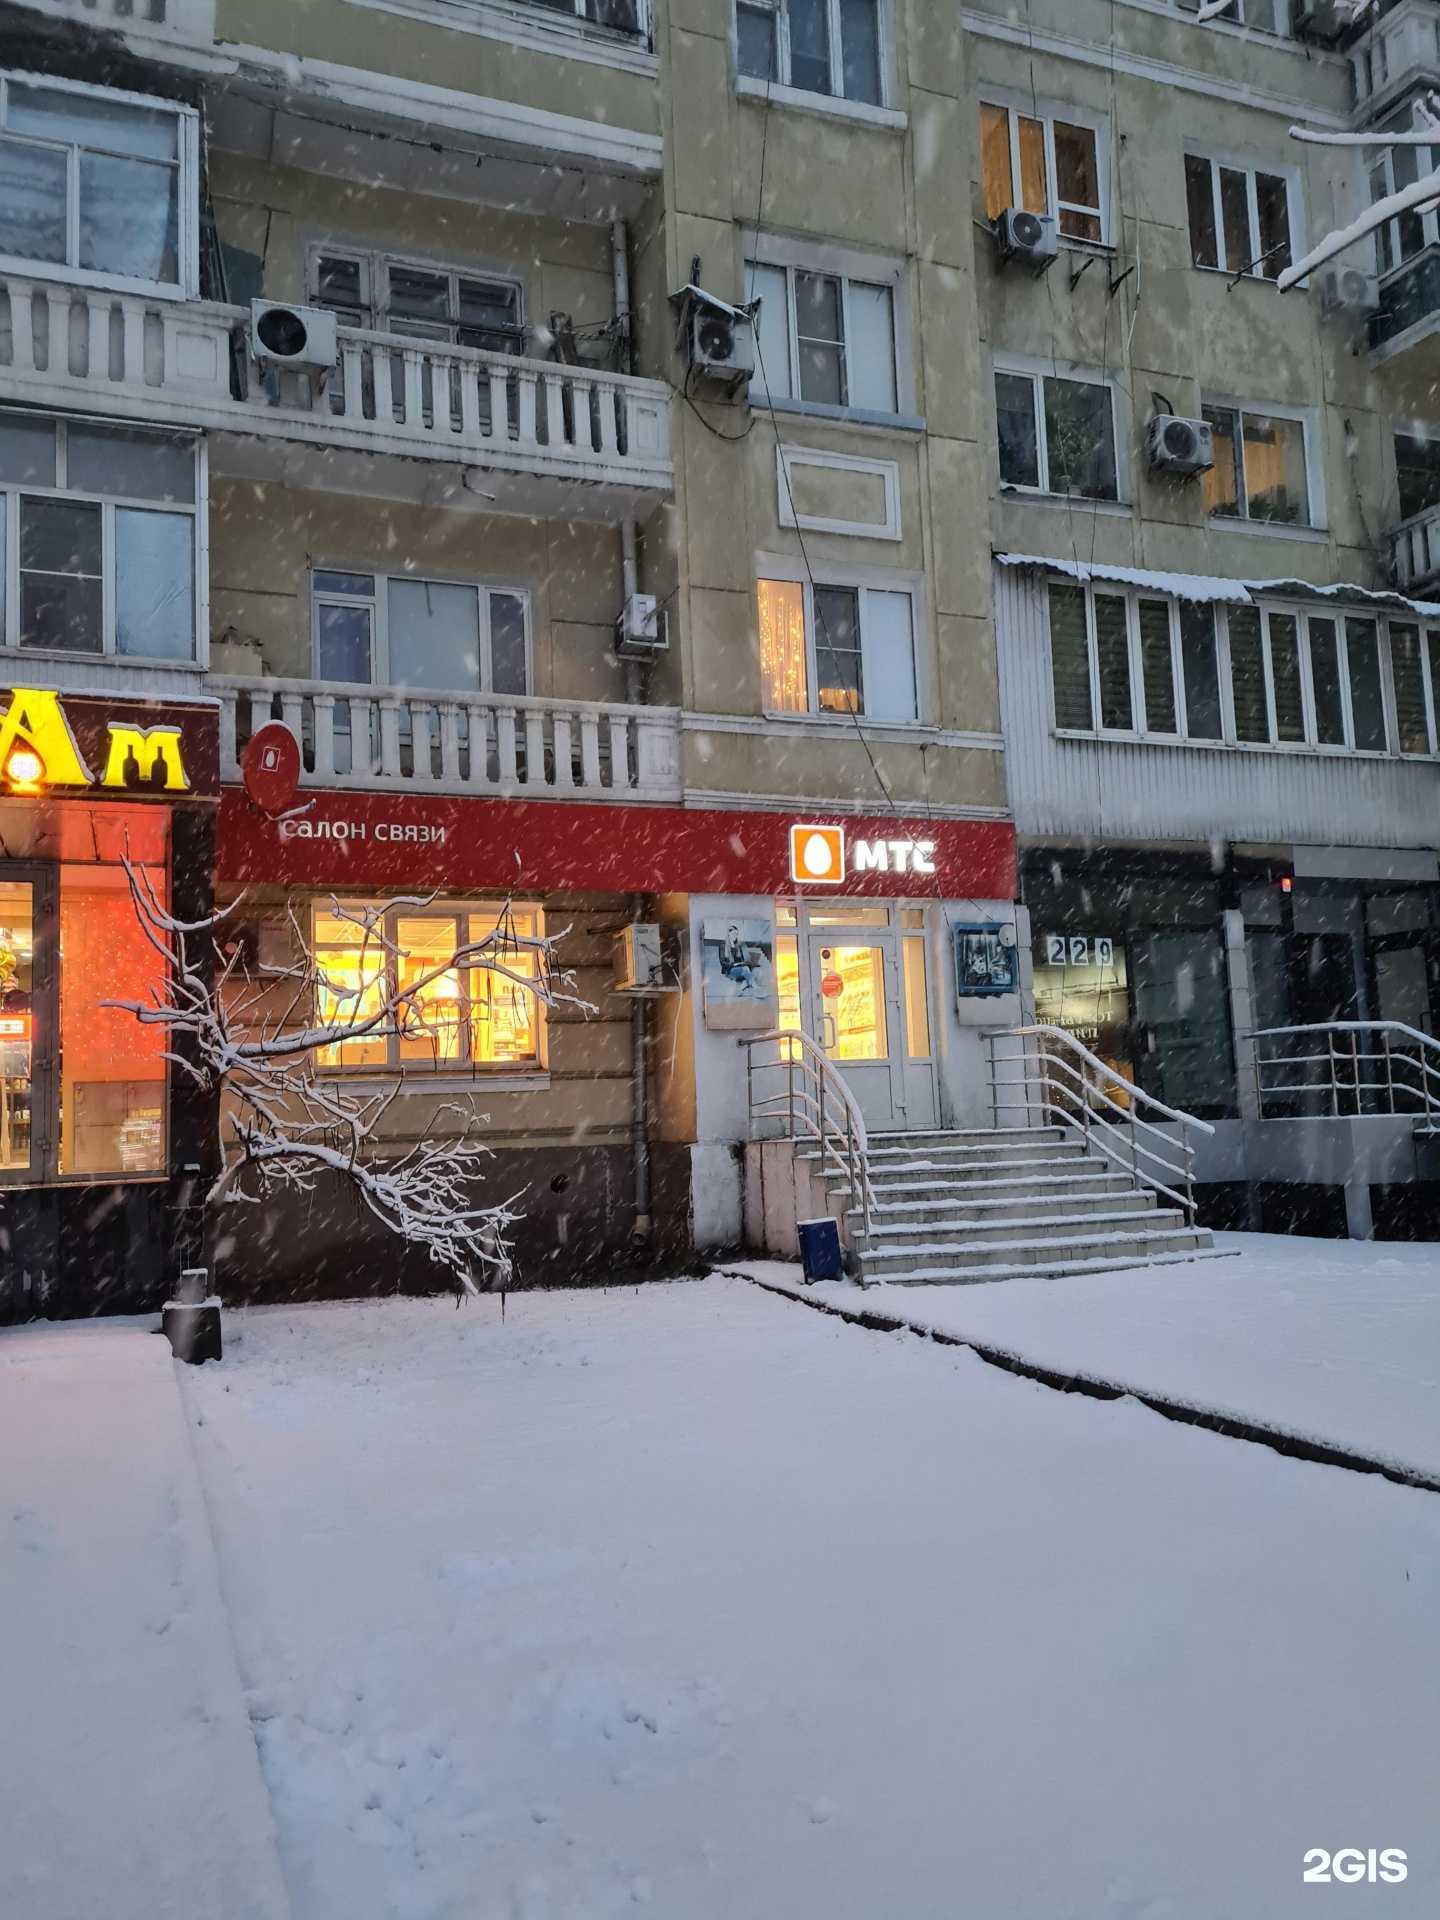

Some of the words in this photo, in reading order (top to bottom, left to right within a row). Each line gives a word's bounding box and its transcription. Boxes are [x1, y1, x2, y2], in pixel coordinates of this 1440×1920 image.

[282, 819, 366, 840] салон
[374, 823, 446, 843] связи
[855, 839, 936, 873] МТС
[1050, 938, 1112, 965] 229
